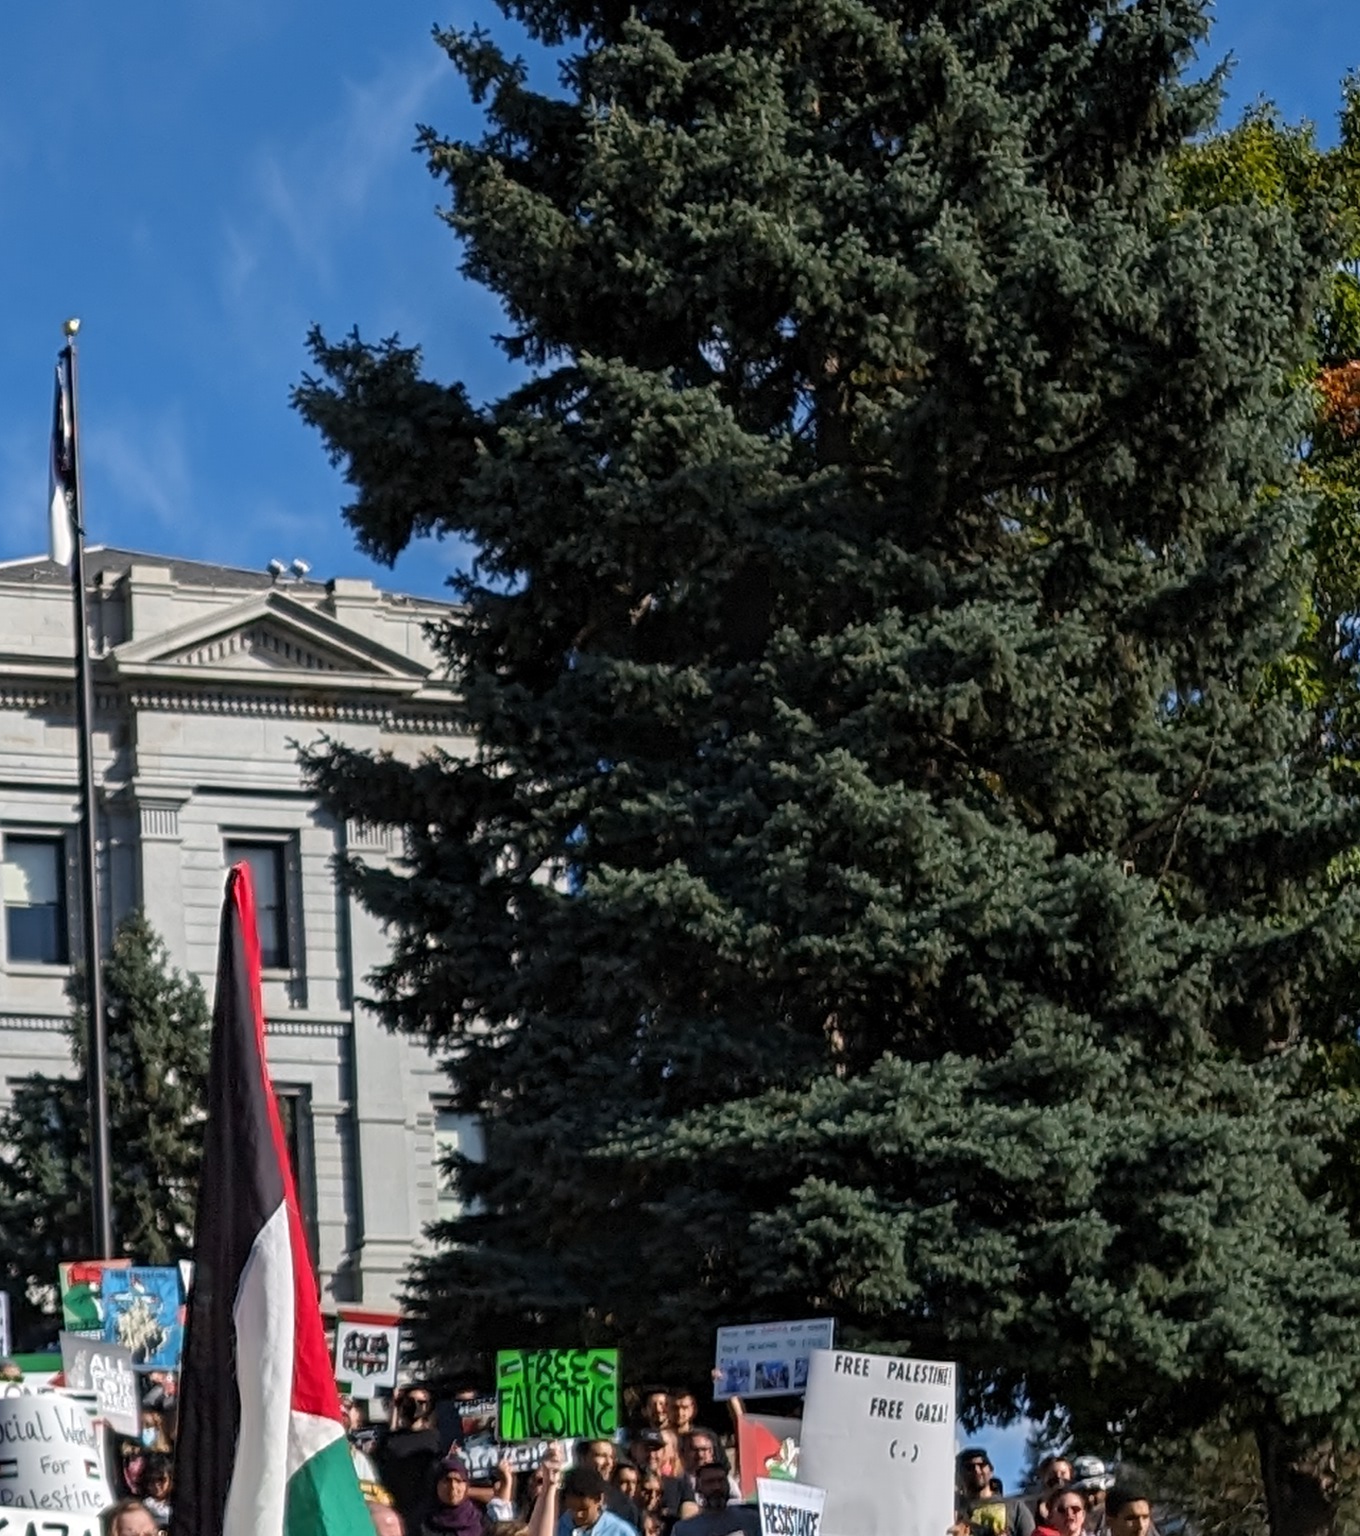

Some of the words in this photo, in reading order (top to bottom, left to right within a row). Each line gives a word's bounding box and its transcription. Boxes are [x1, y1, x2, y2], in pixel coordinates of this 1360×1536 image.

[520, 1349, 590, 1385] FREE
[834, 1355, 870, 1377] FREE
[887, 1362, 952, 1387] PALESTINE!
[869, 1398, 903, 1419] FREE
[915, 1403, 948, 1423] GAZA!
[40, 1454, 71, 1474] For
[0, 1484, 104, 1510] Palestine
